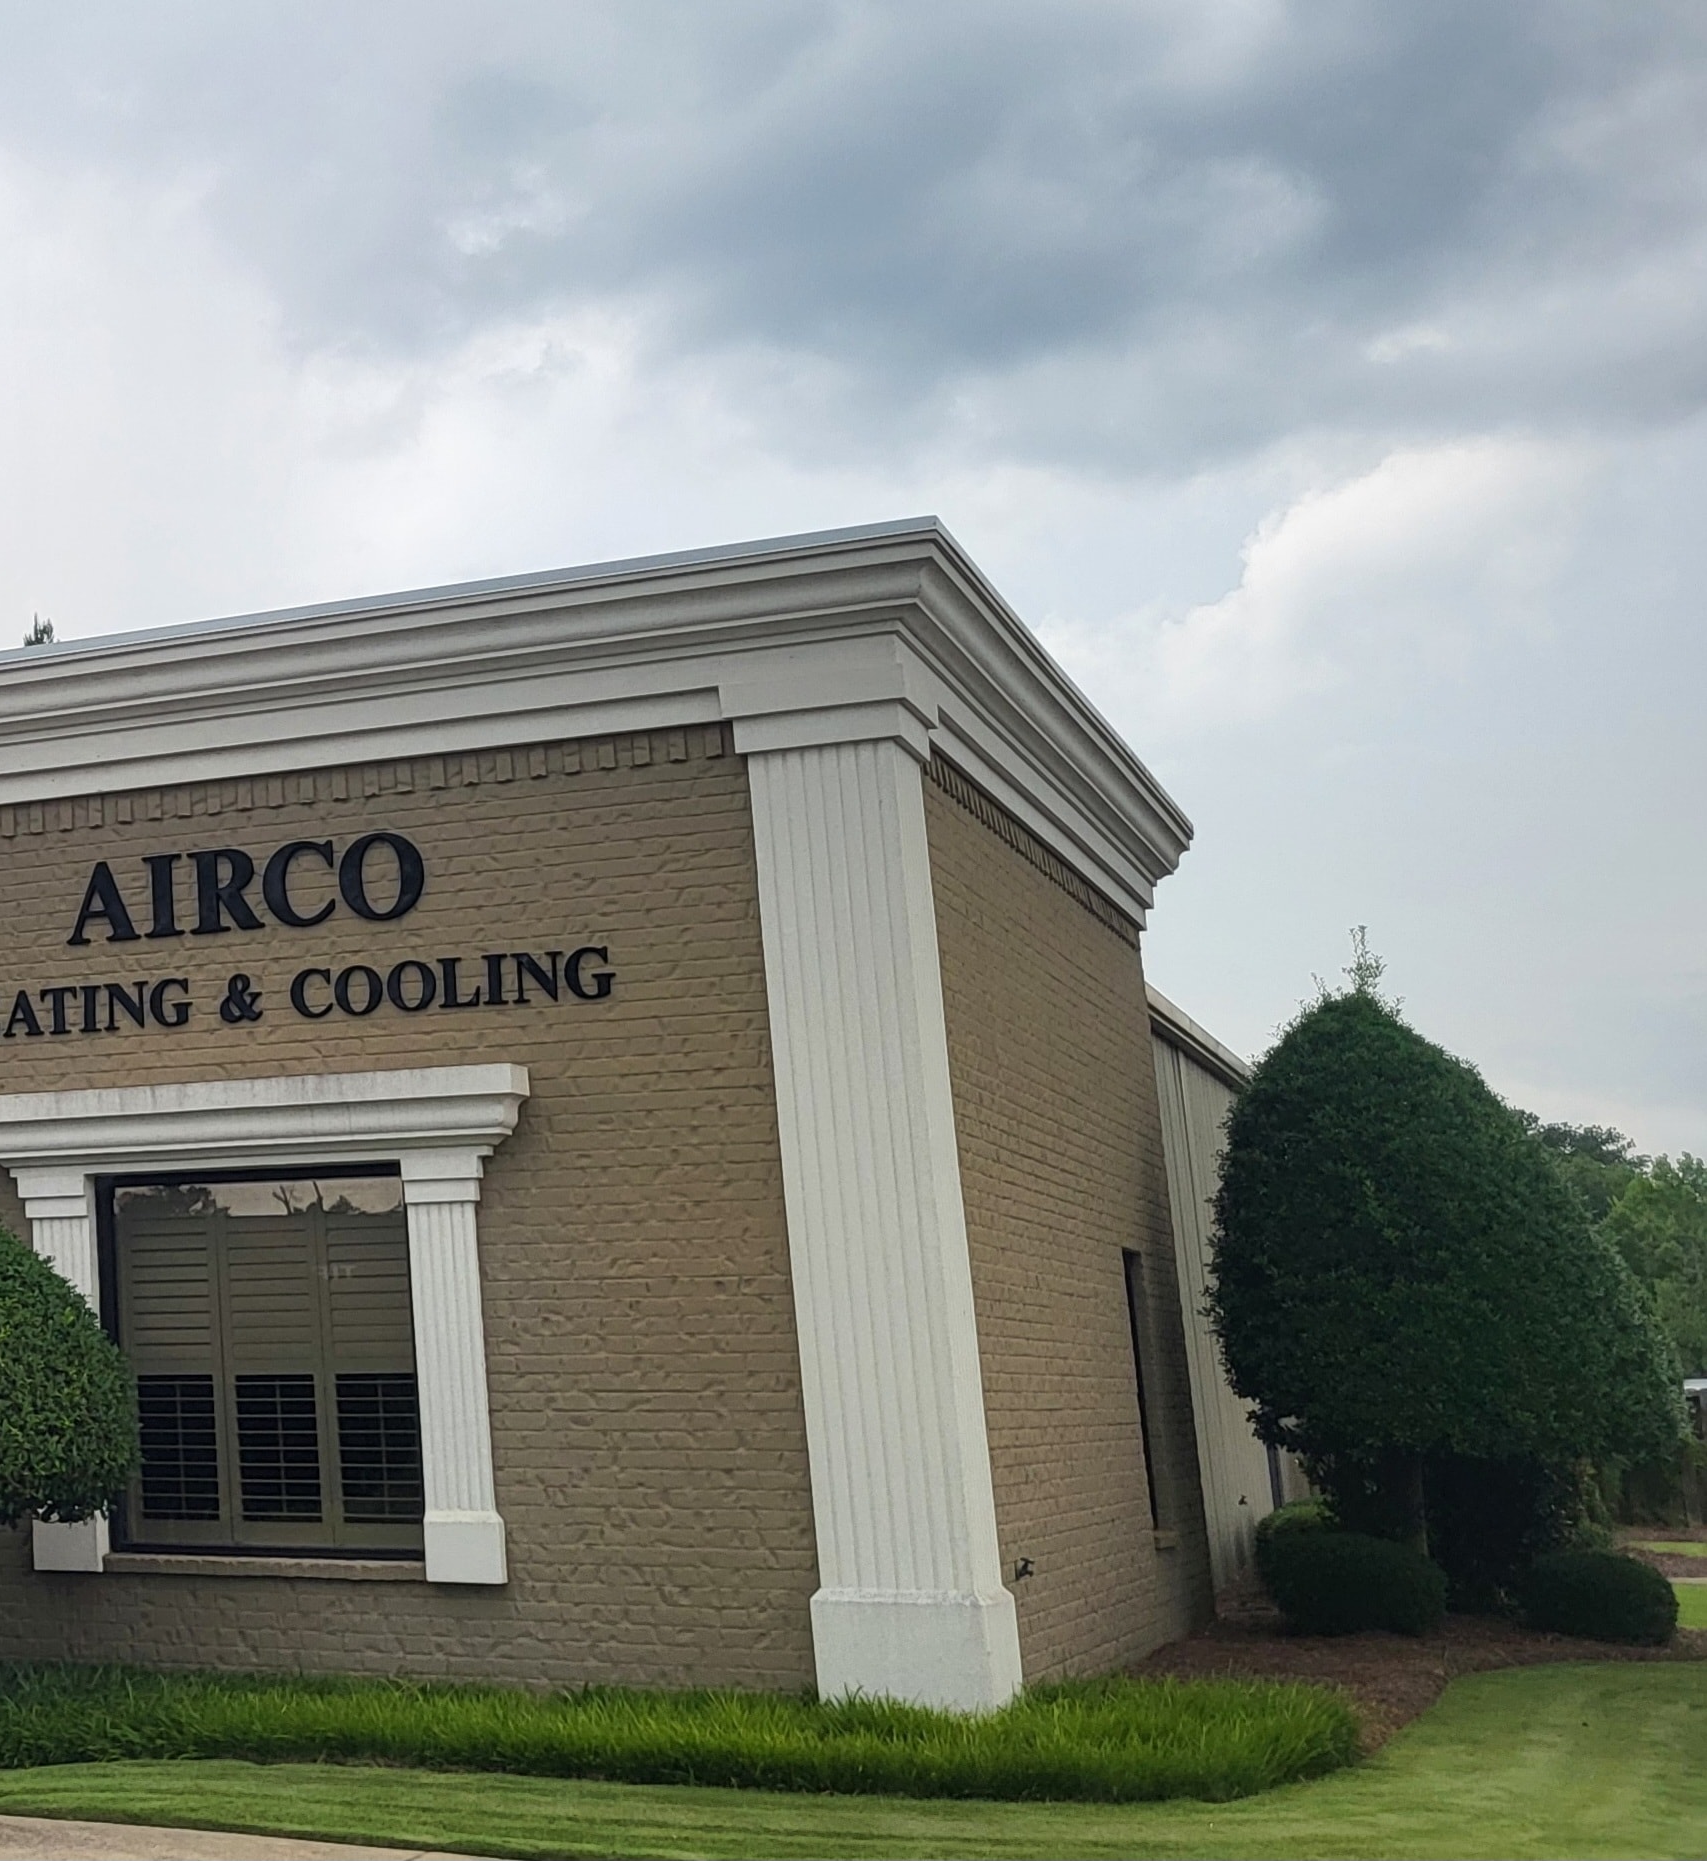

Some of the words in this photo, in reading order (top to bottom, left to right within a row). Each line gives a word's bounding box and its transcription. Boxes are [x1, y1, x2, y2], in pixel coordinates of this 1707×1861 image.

[66, 829, 425, 946] AIRCO
[219, 972, 264, 1024] &
[289, 946, 616, 1019] COOLING
